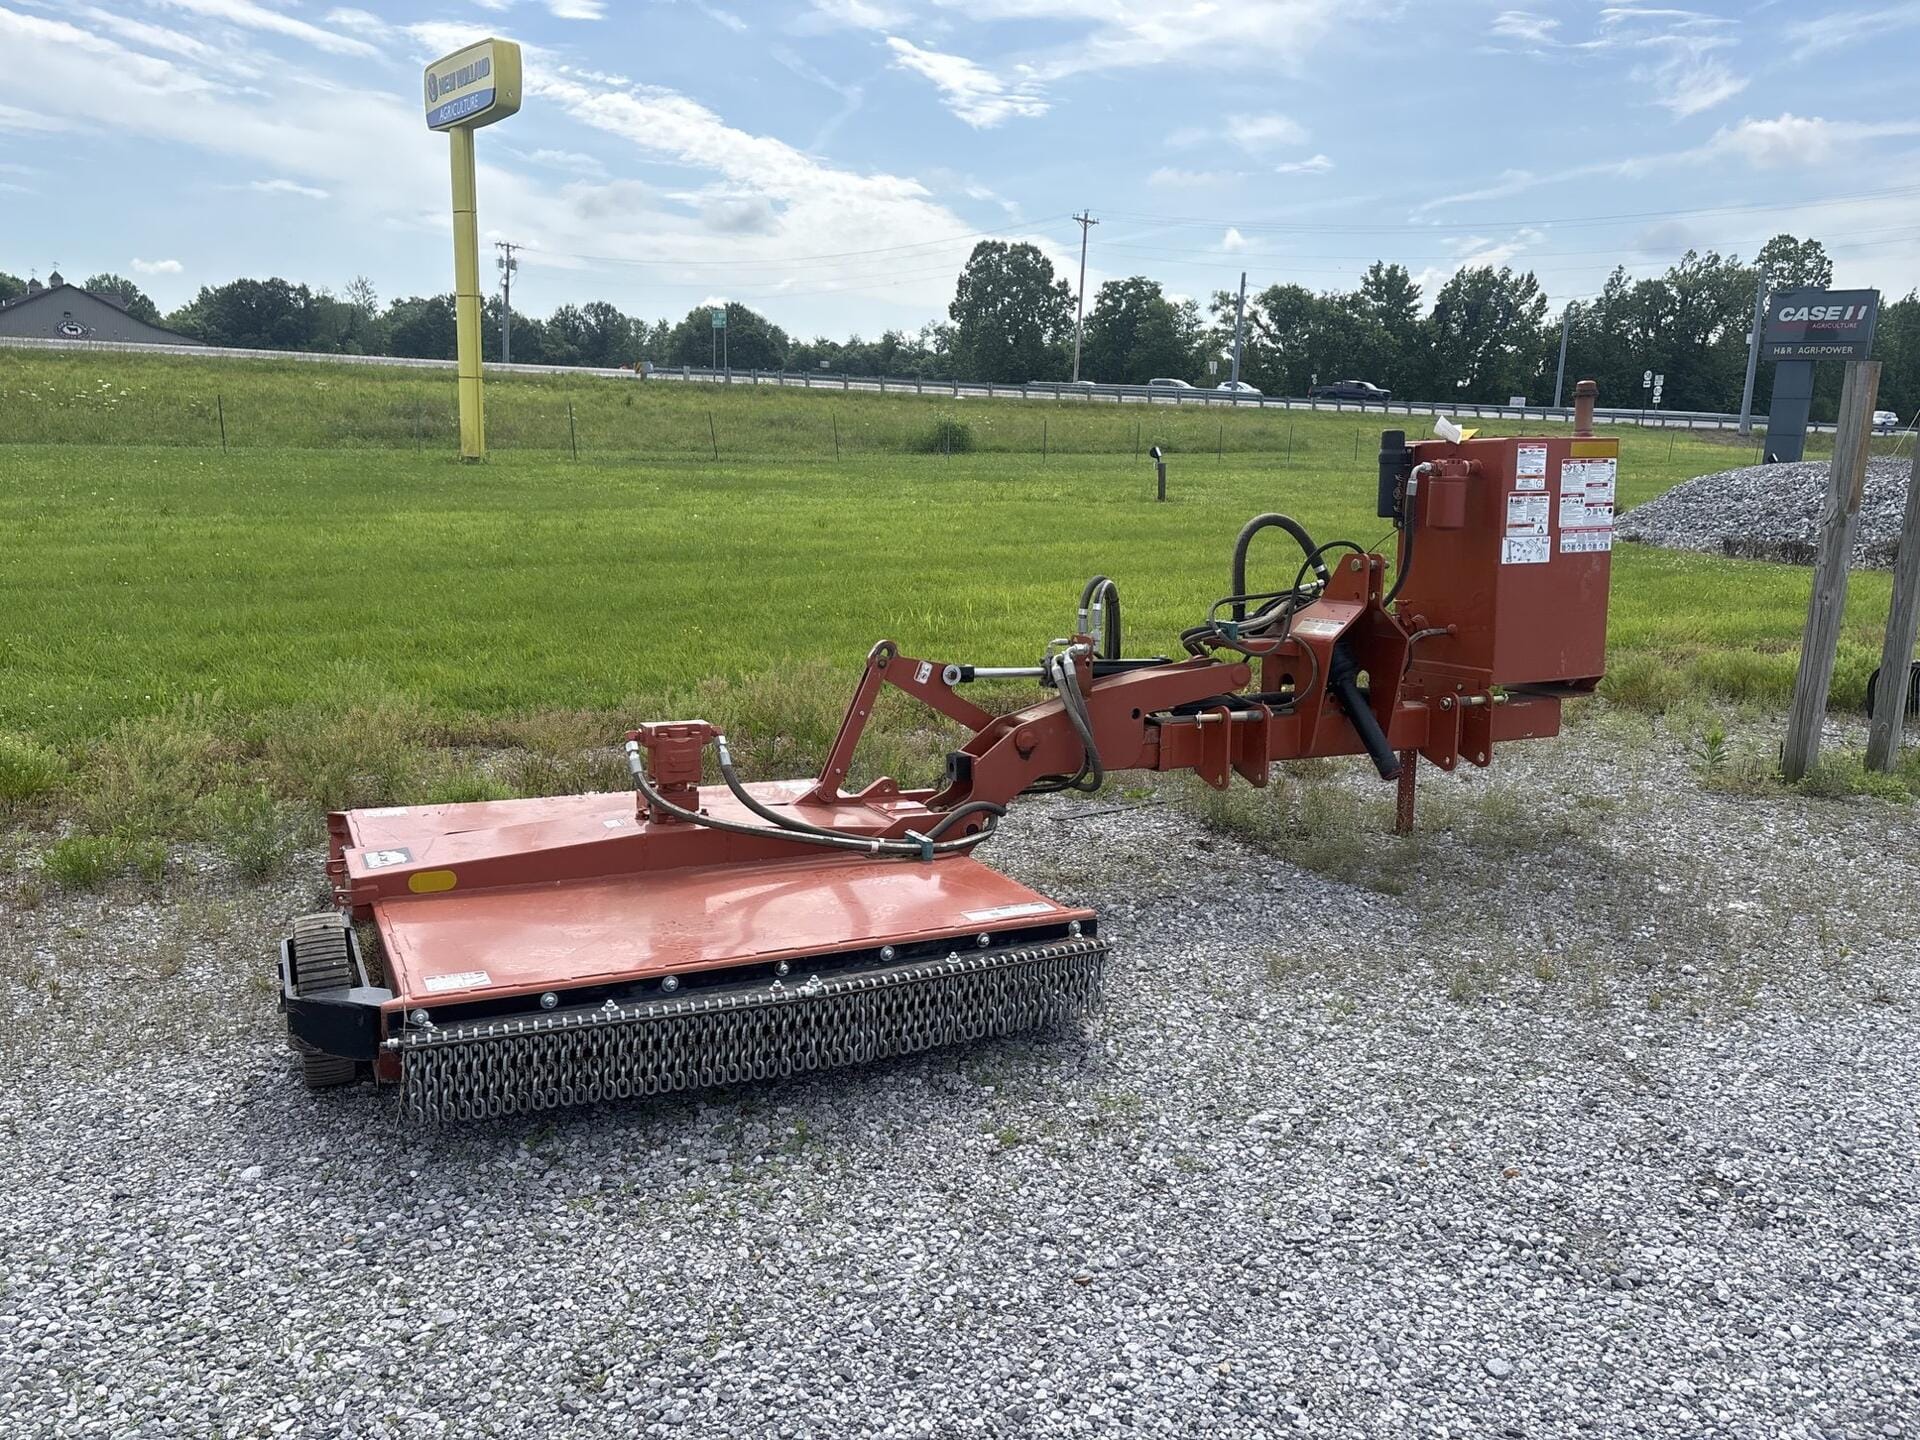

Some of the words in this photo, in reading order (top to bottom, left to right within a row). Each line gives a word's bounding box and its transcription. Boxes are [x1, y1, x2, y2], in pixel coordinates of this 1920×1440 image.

[439, 94, 479, 121] AGRICULTURE
[1778, 306, 1843, 322] CASE
[1773, 346, 1792, 355] H&R
[1797, 346, 1854, 355] AGRI-POWER
